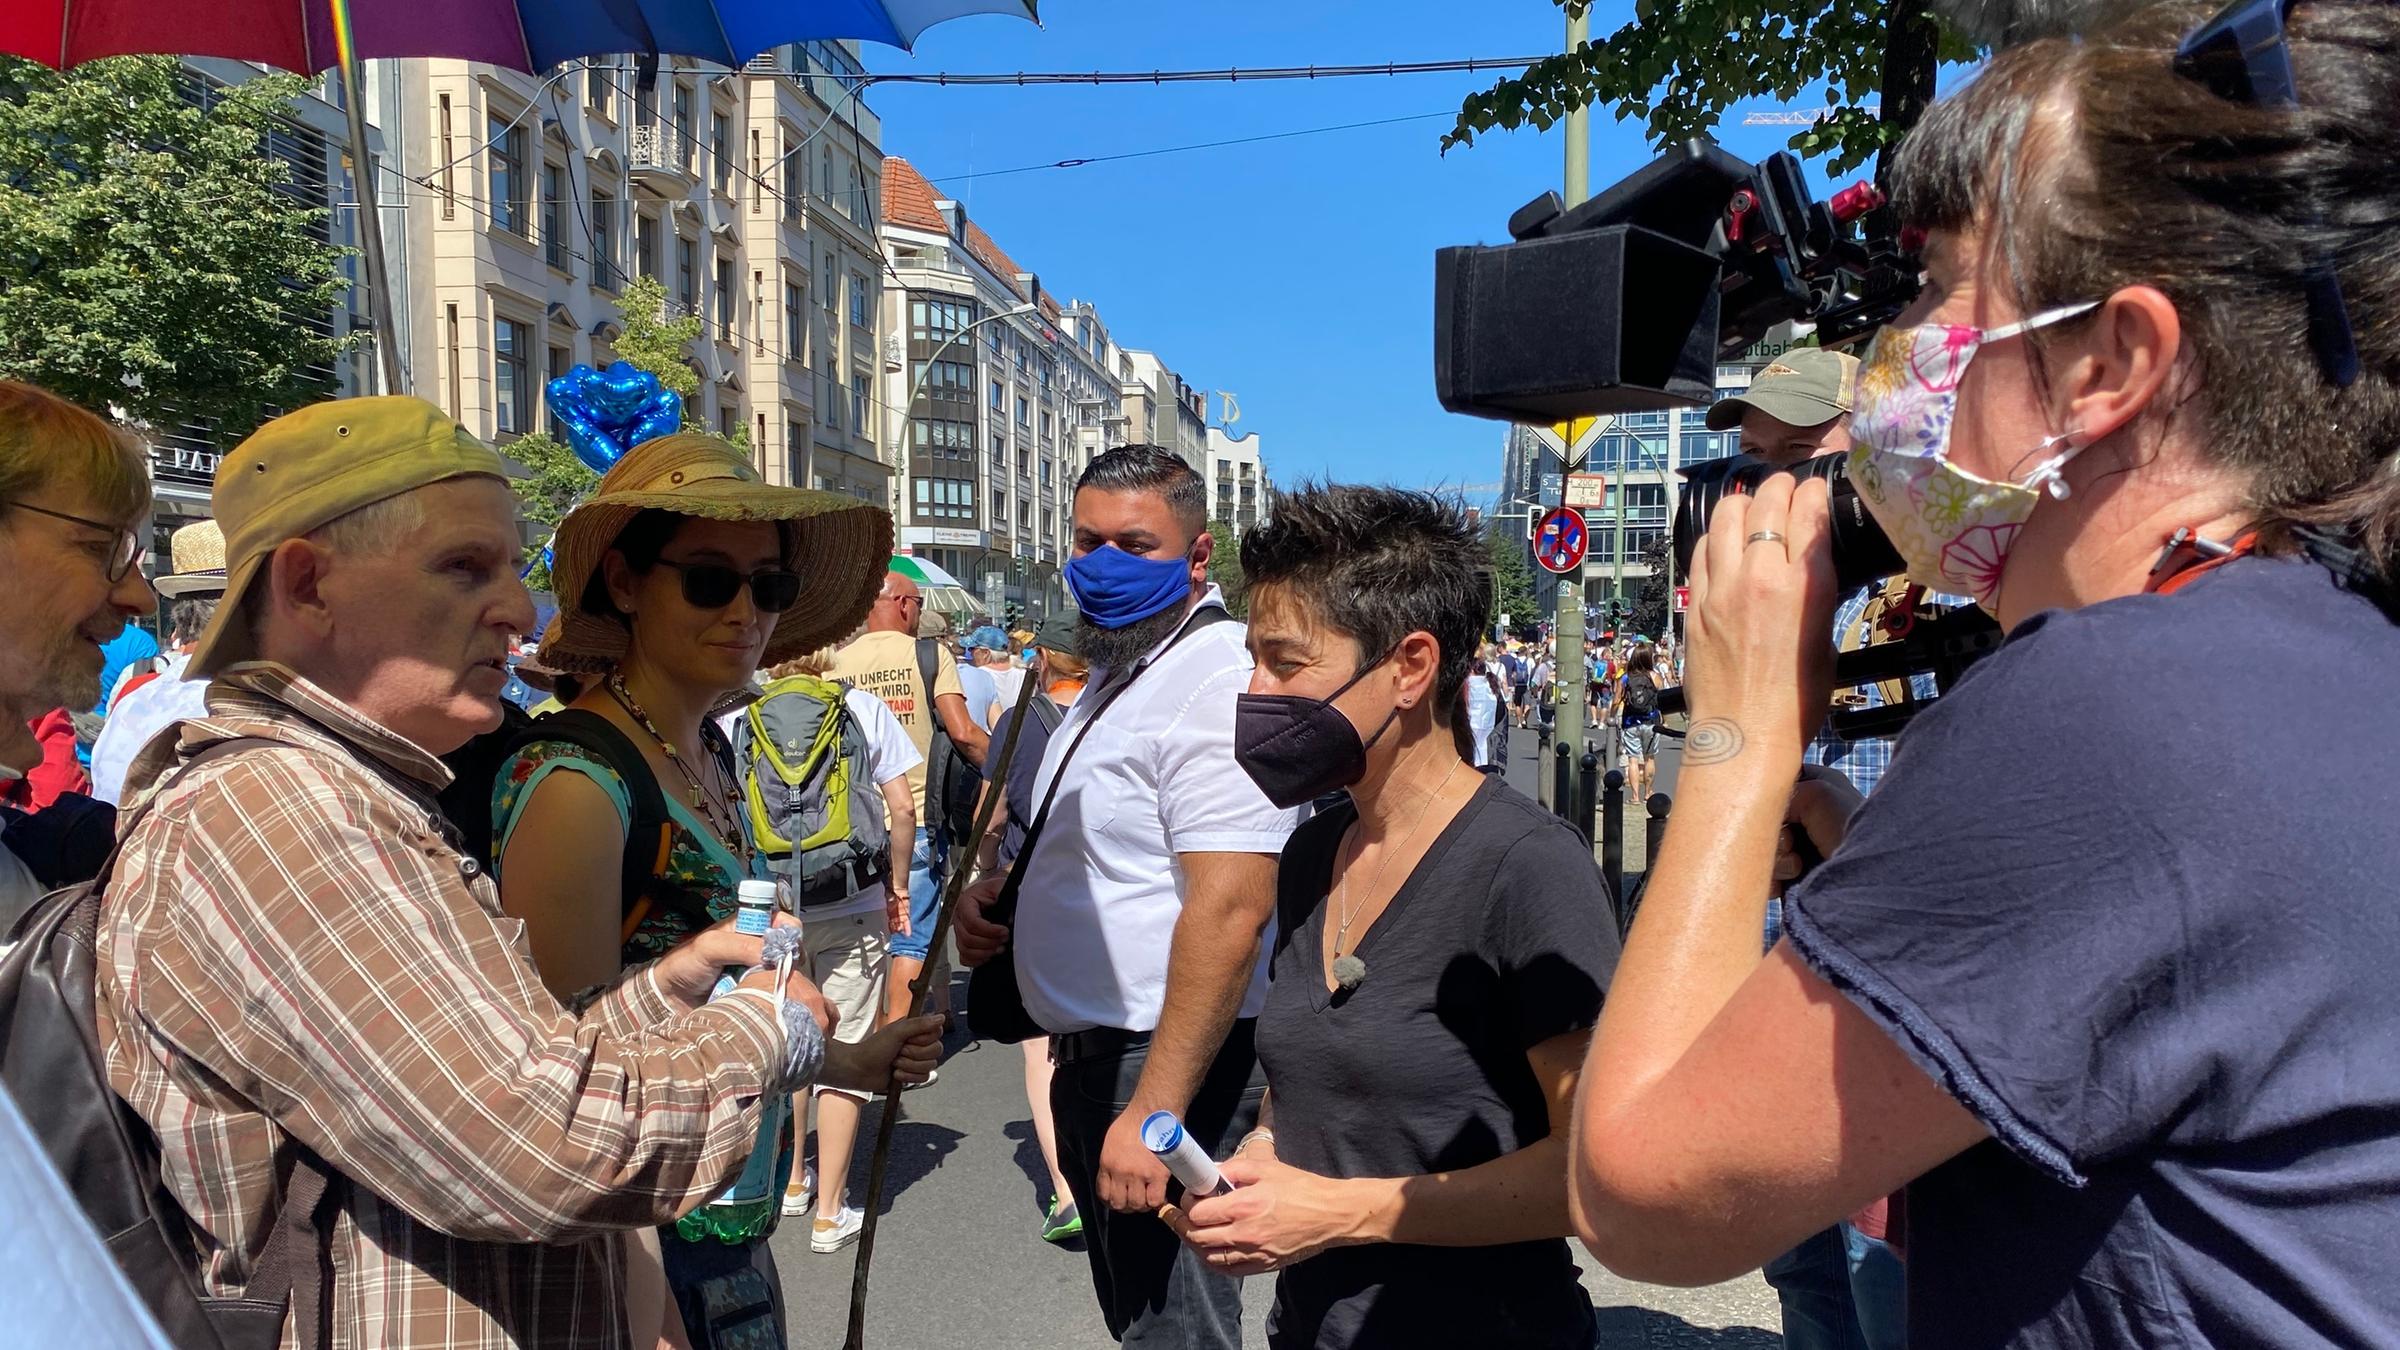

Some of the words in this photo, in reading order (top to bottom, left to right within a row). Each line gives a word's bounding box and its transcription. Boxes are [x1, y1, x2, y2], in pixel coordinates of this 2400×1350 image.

[1852, 496, 1864, 527] Canon
[860, 668, 912, 685] UNRECHT
[881, 684, 914, 699] WIRD,
[884, 699, 914, 712] TAND
